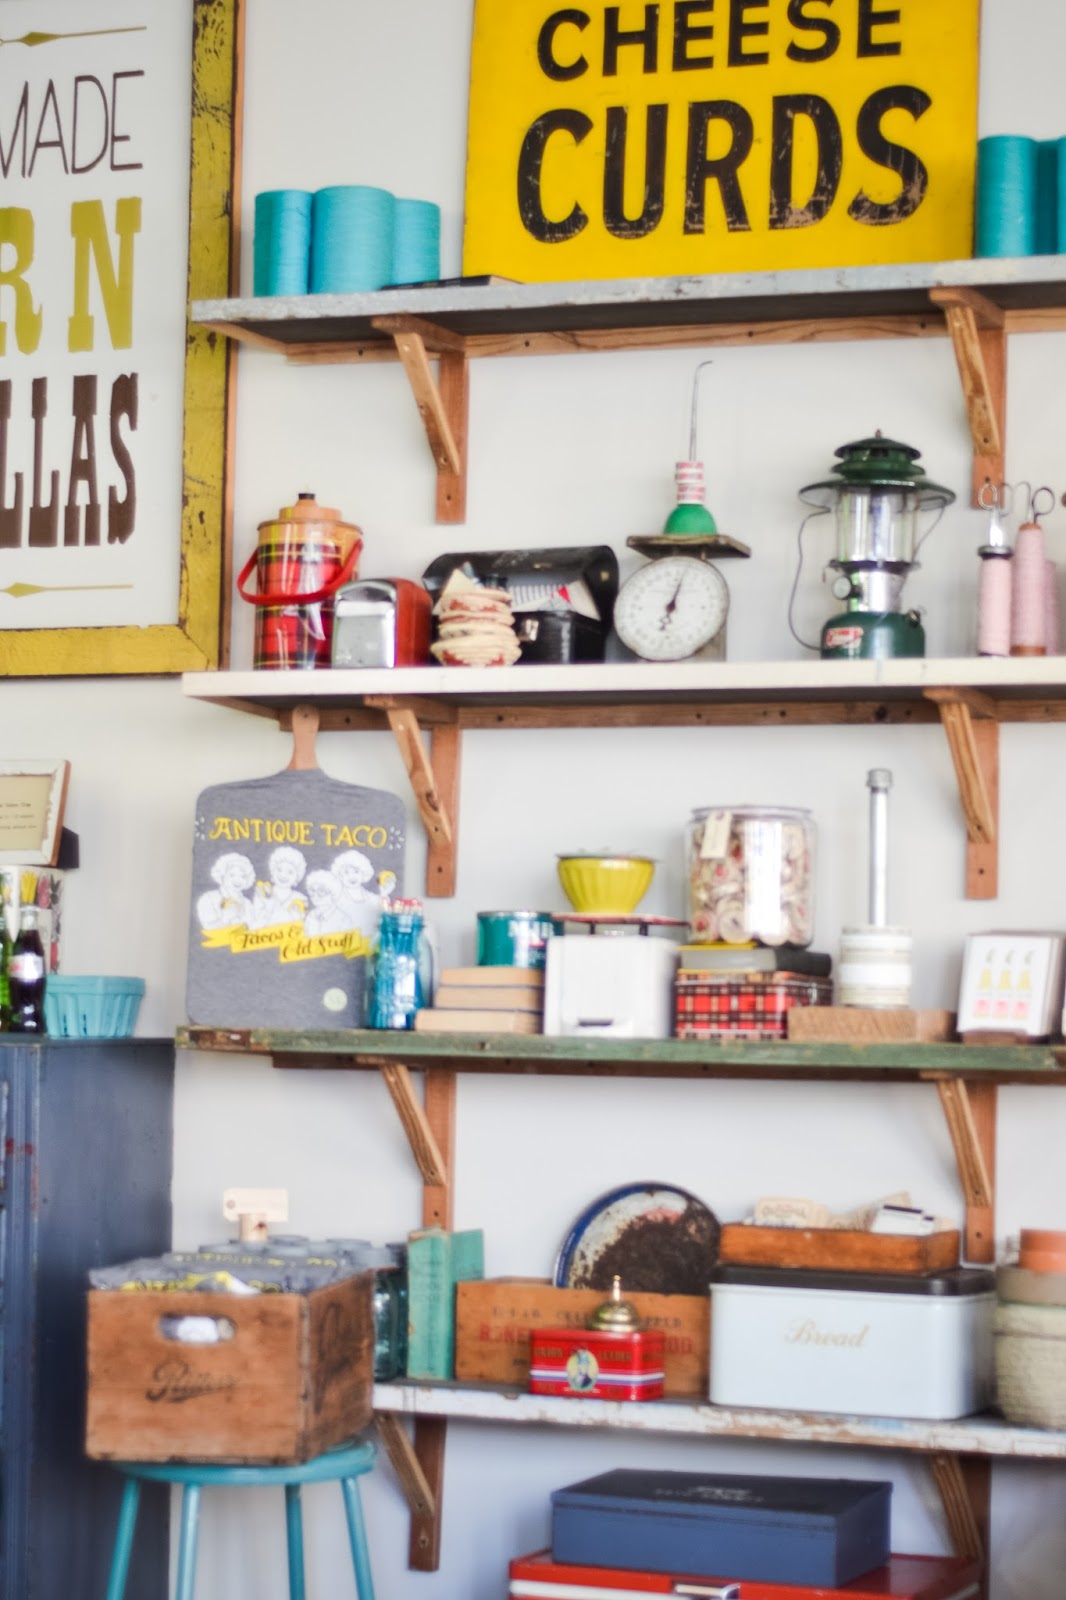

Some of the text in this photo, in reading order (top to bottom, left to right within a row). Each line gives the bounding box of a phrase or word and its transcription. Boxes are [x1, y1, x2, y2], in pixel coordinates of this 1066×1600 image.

[537, 0, 902, 81] CHEESE
[0, 70, 144, 179] MADE
[517, 85, 932, 243] CURDS
[0, 197, 142, 357] RN
[0, 372, 138, 548] LLAS
[208, 816, 388, 848] ANTIQUE TACO
[240, 930, 284, 949] Tacos
[282, 932, 354, 959] Old Stuff
[784, 1316, 870, 1347] Bread
